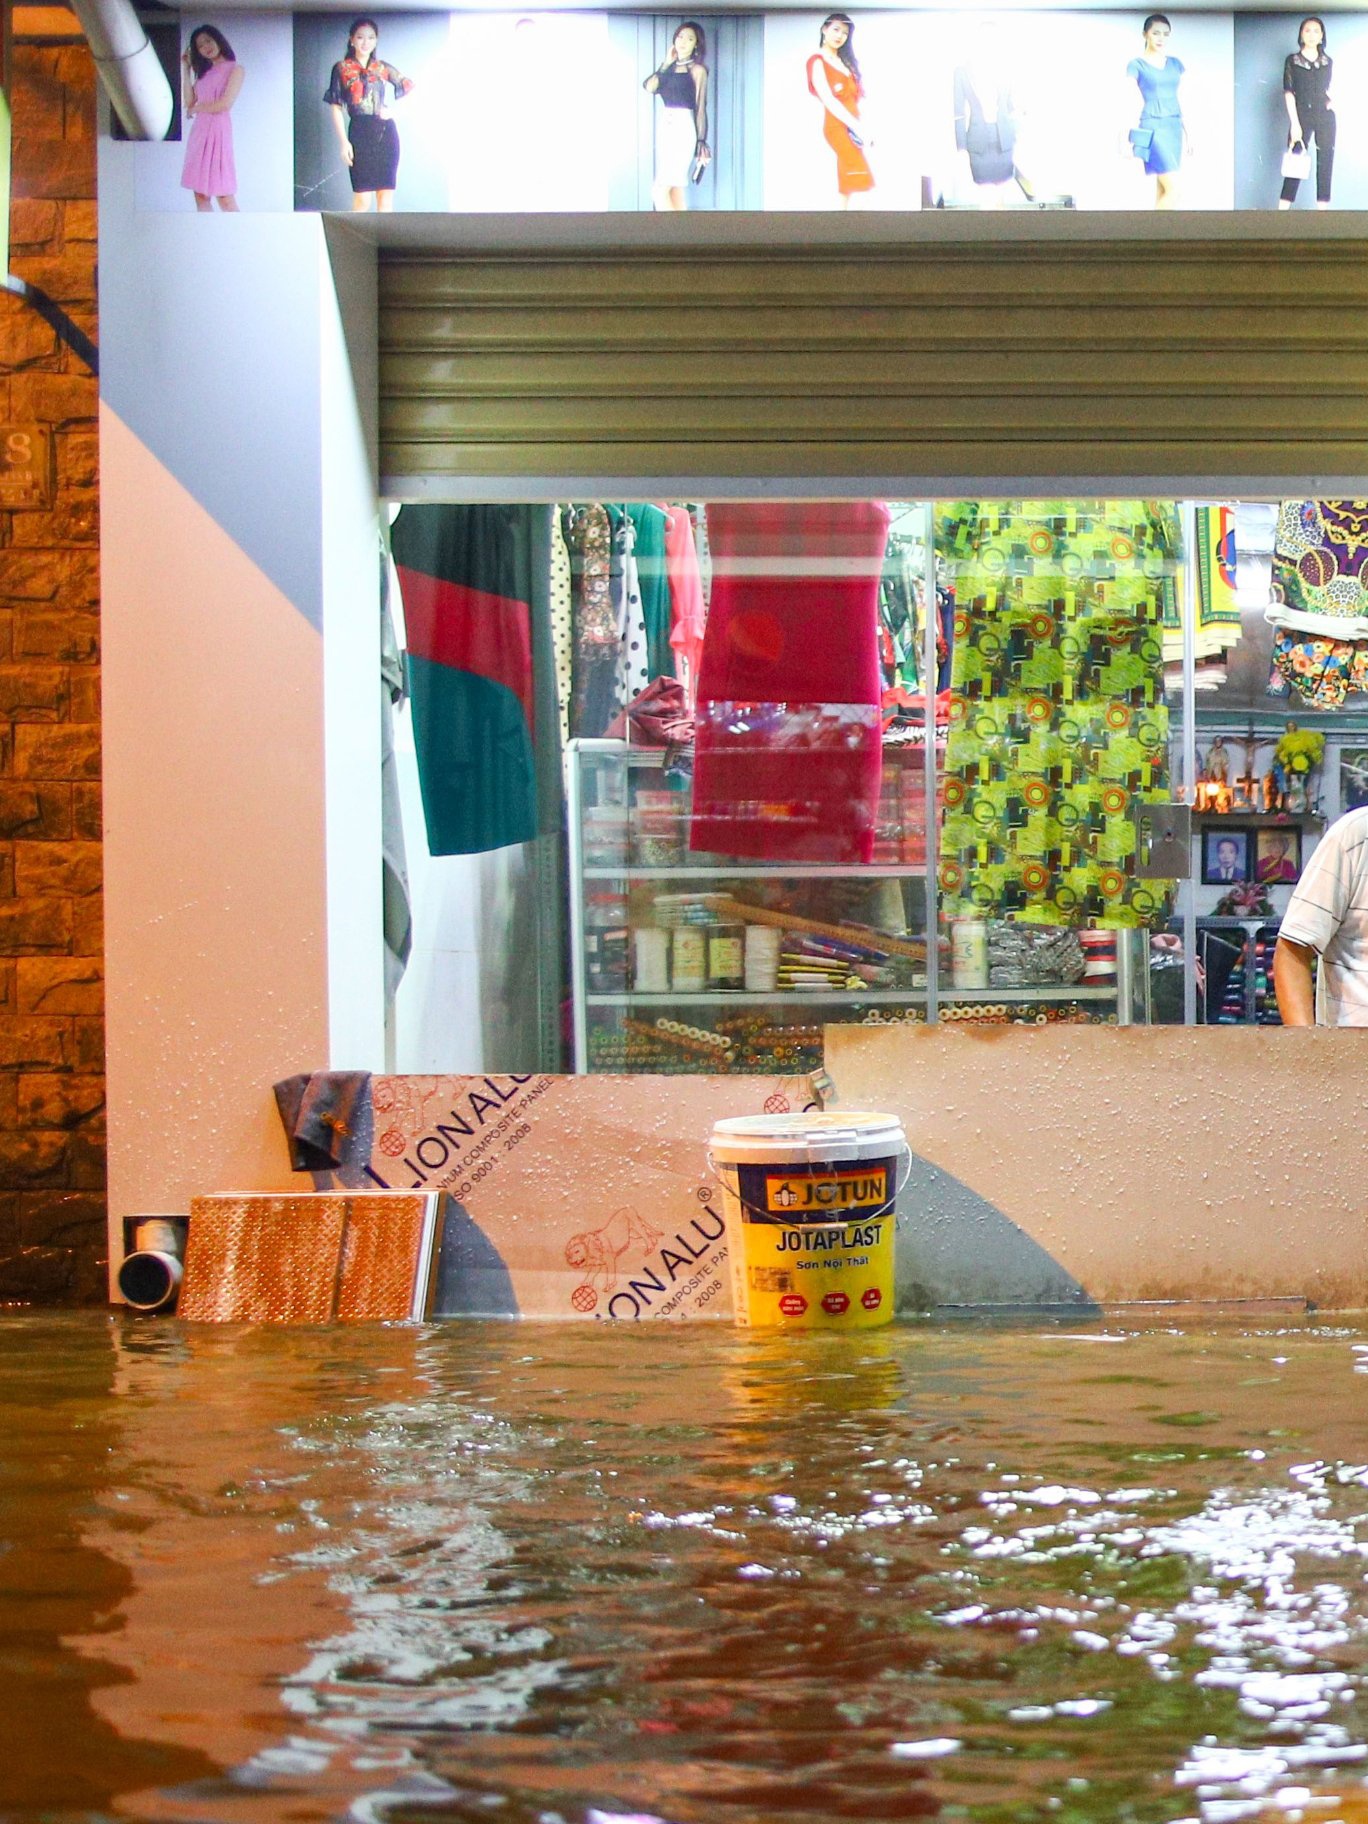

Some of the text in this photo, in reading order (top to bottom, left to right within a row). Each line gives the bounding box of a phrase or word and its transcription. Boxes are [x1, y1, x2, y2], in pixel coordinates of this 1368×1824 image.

[463, 1106, 522, 1167] COMPOSITE
[519, 1079, 555, 1110] PANEL
[471, 1155, 499, 1183] 9001
[503, 1122, 533, 1151] 2008
[802, 1178, 884, 1206] JOTUN
[776, 1224, 883, 1252] JOTAPLAST
[595, 1204, 727, 1319] ONALU
[694, 1279, 723, 1309] 2008
